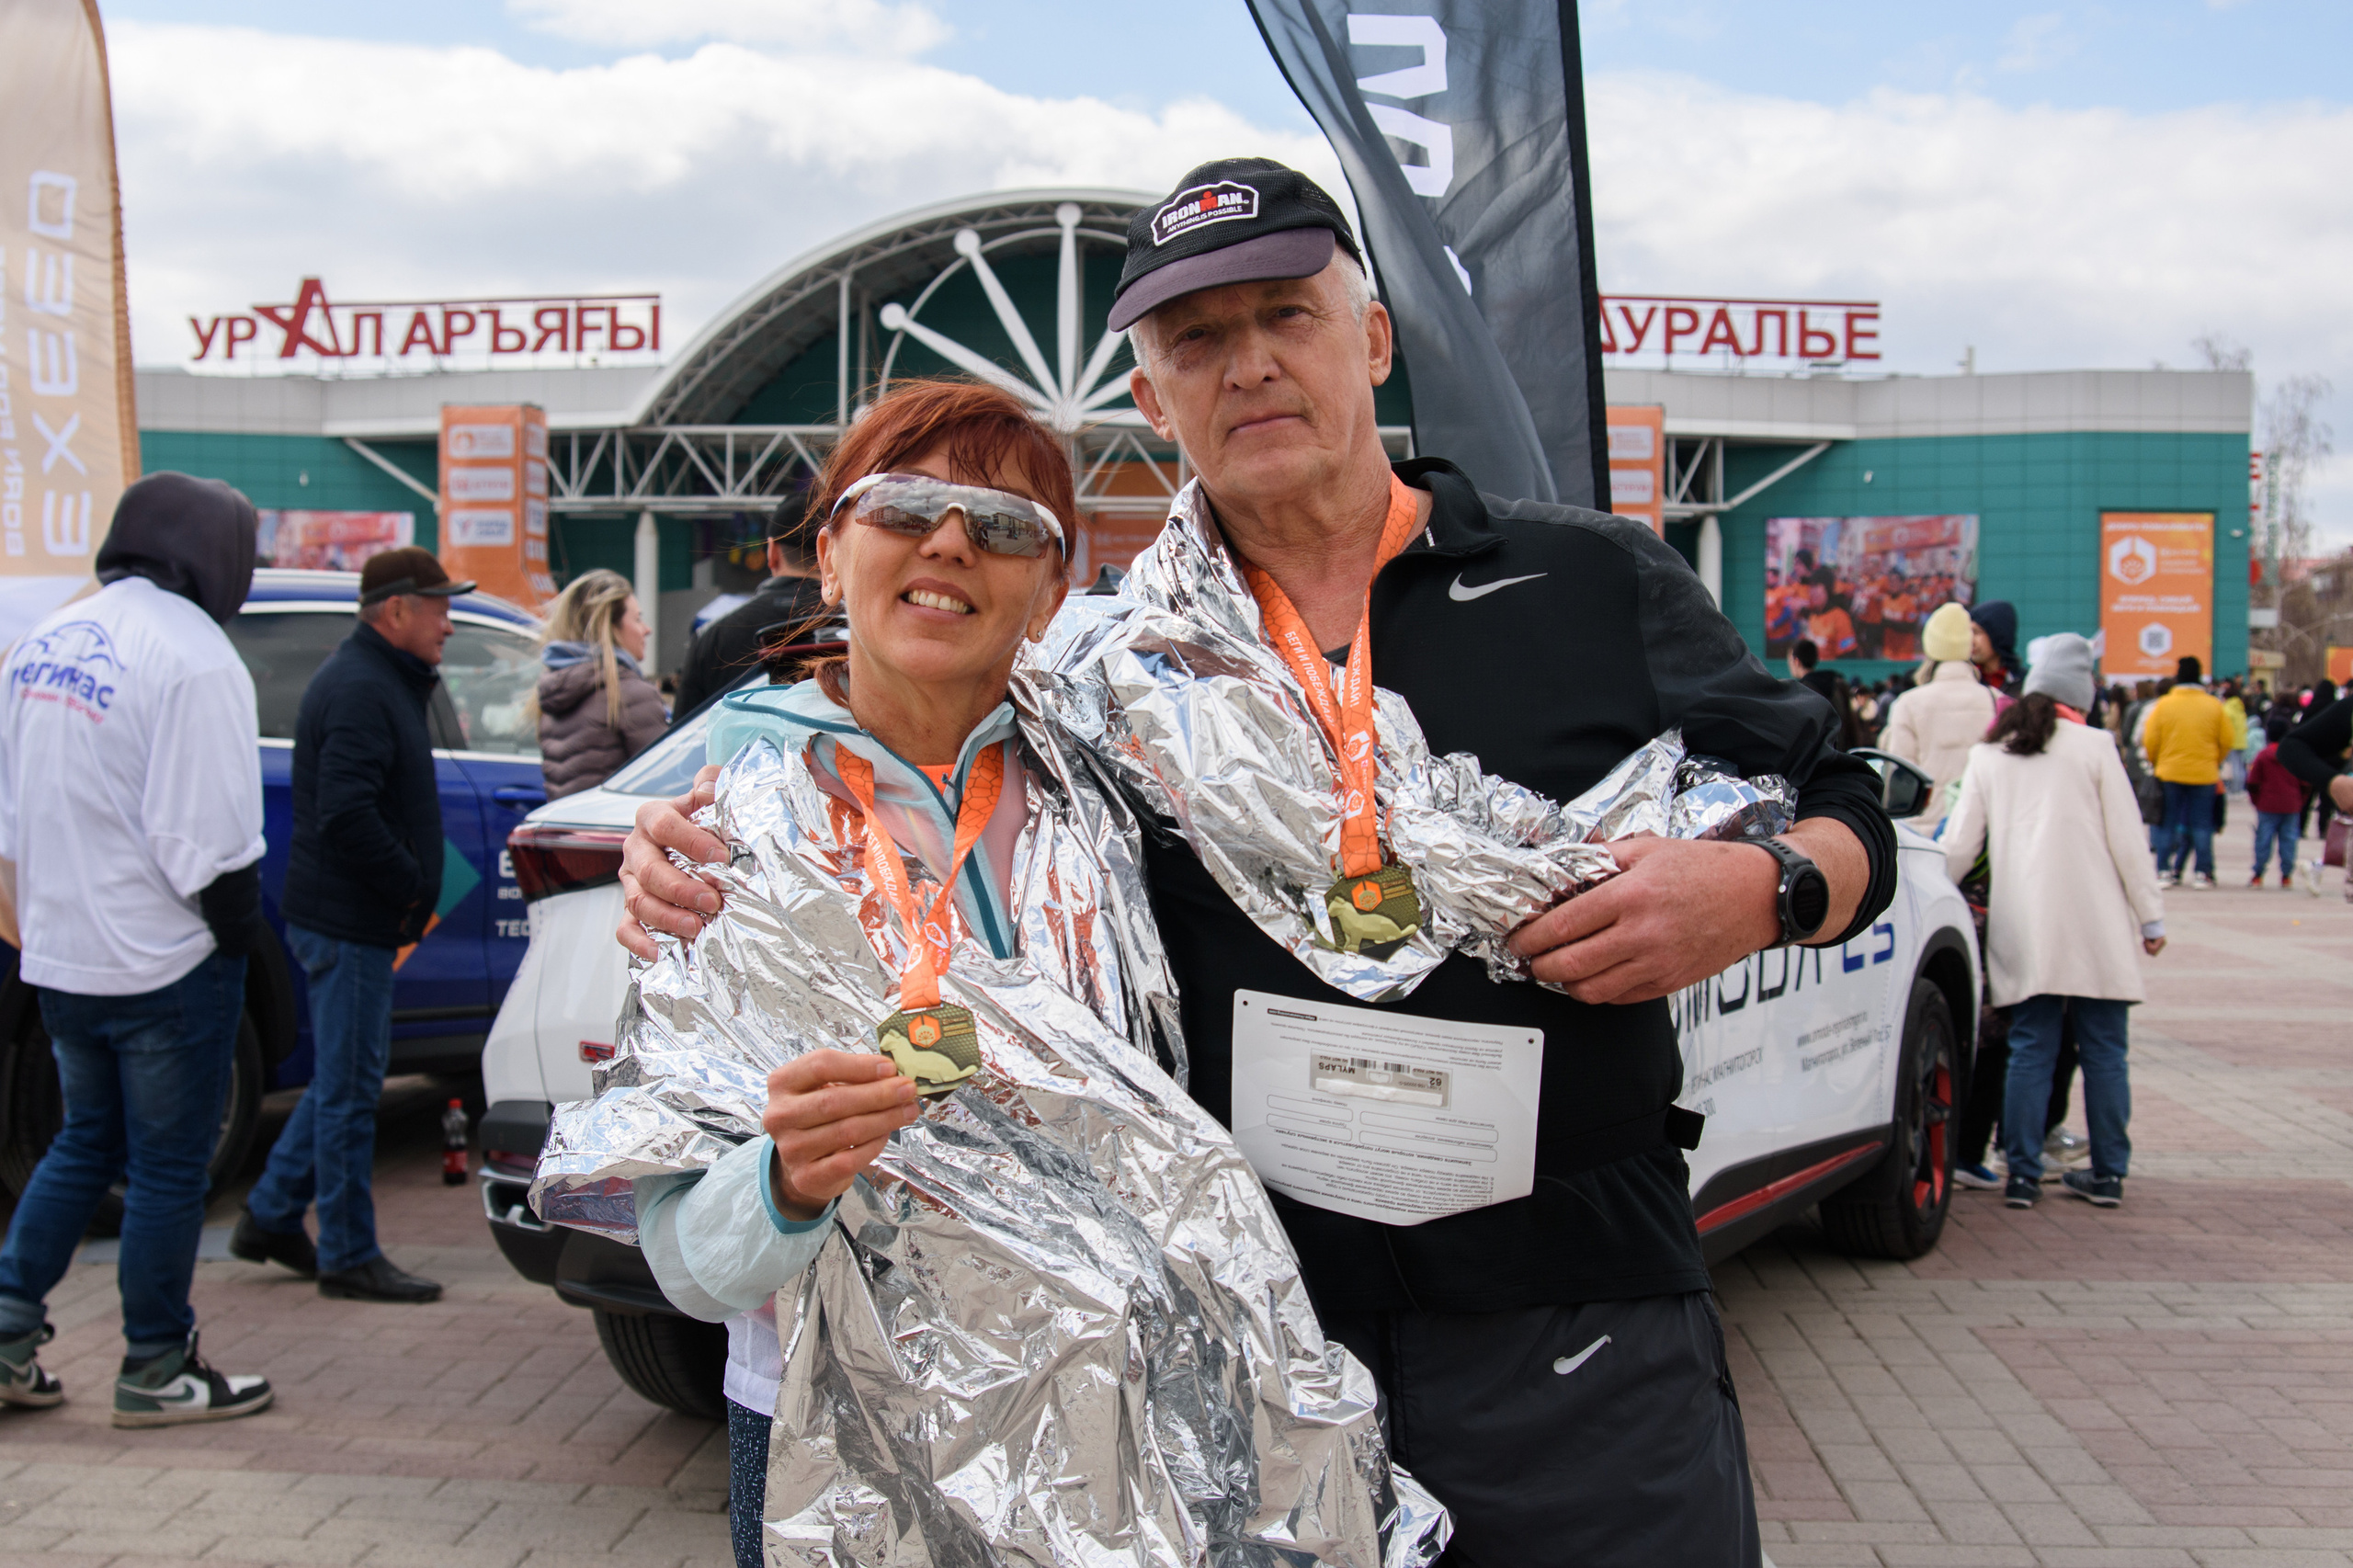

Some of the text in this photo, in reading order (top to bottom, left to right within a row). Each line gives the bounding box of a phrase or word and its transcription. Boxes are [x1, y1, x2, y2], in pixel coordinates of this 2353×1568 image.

[1162, 190, 1243, 229] IRONMAN
[1167, 215, 1199, 233] ANYTHING
[1208, 205, 1244, 218] POSSIBLE
[189, 277, 383, 359] УРАЛ
[1285, 631, 1305, 653] БЕГИ
[1297, 652, 1310, 663] И
[1317, 1061, 1355, 1074] MYLAPS
[1429, 1077, 1441, 1086] 62
